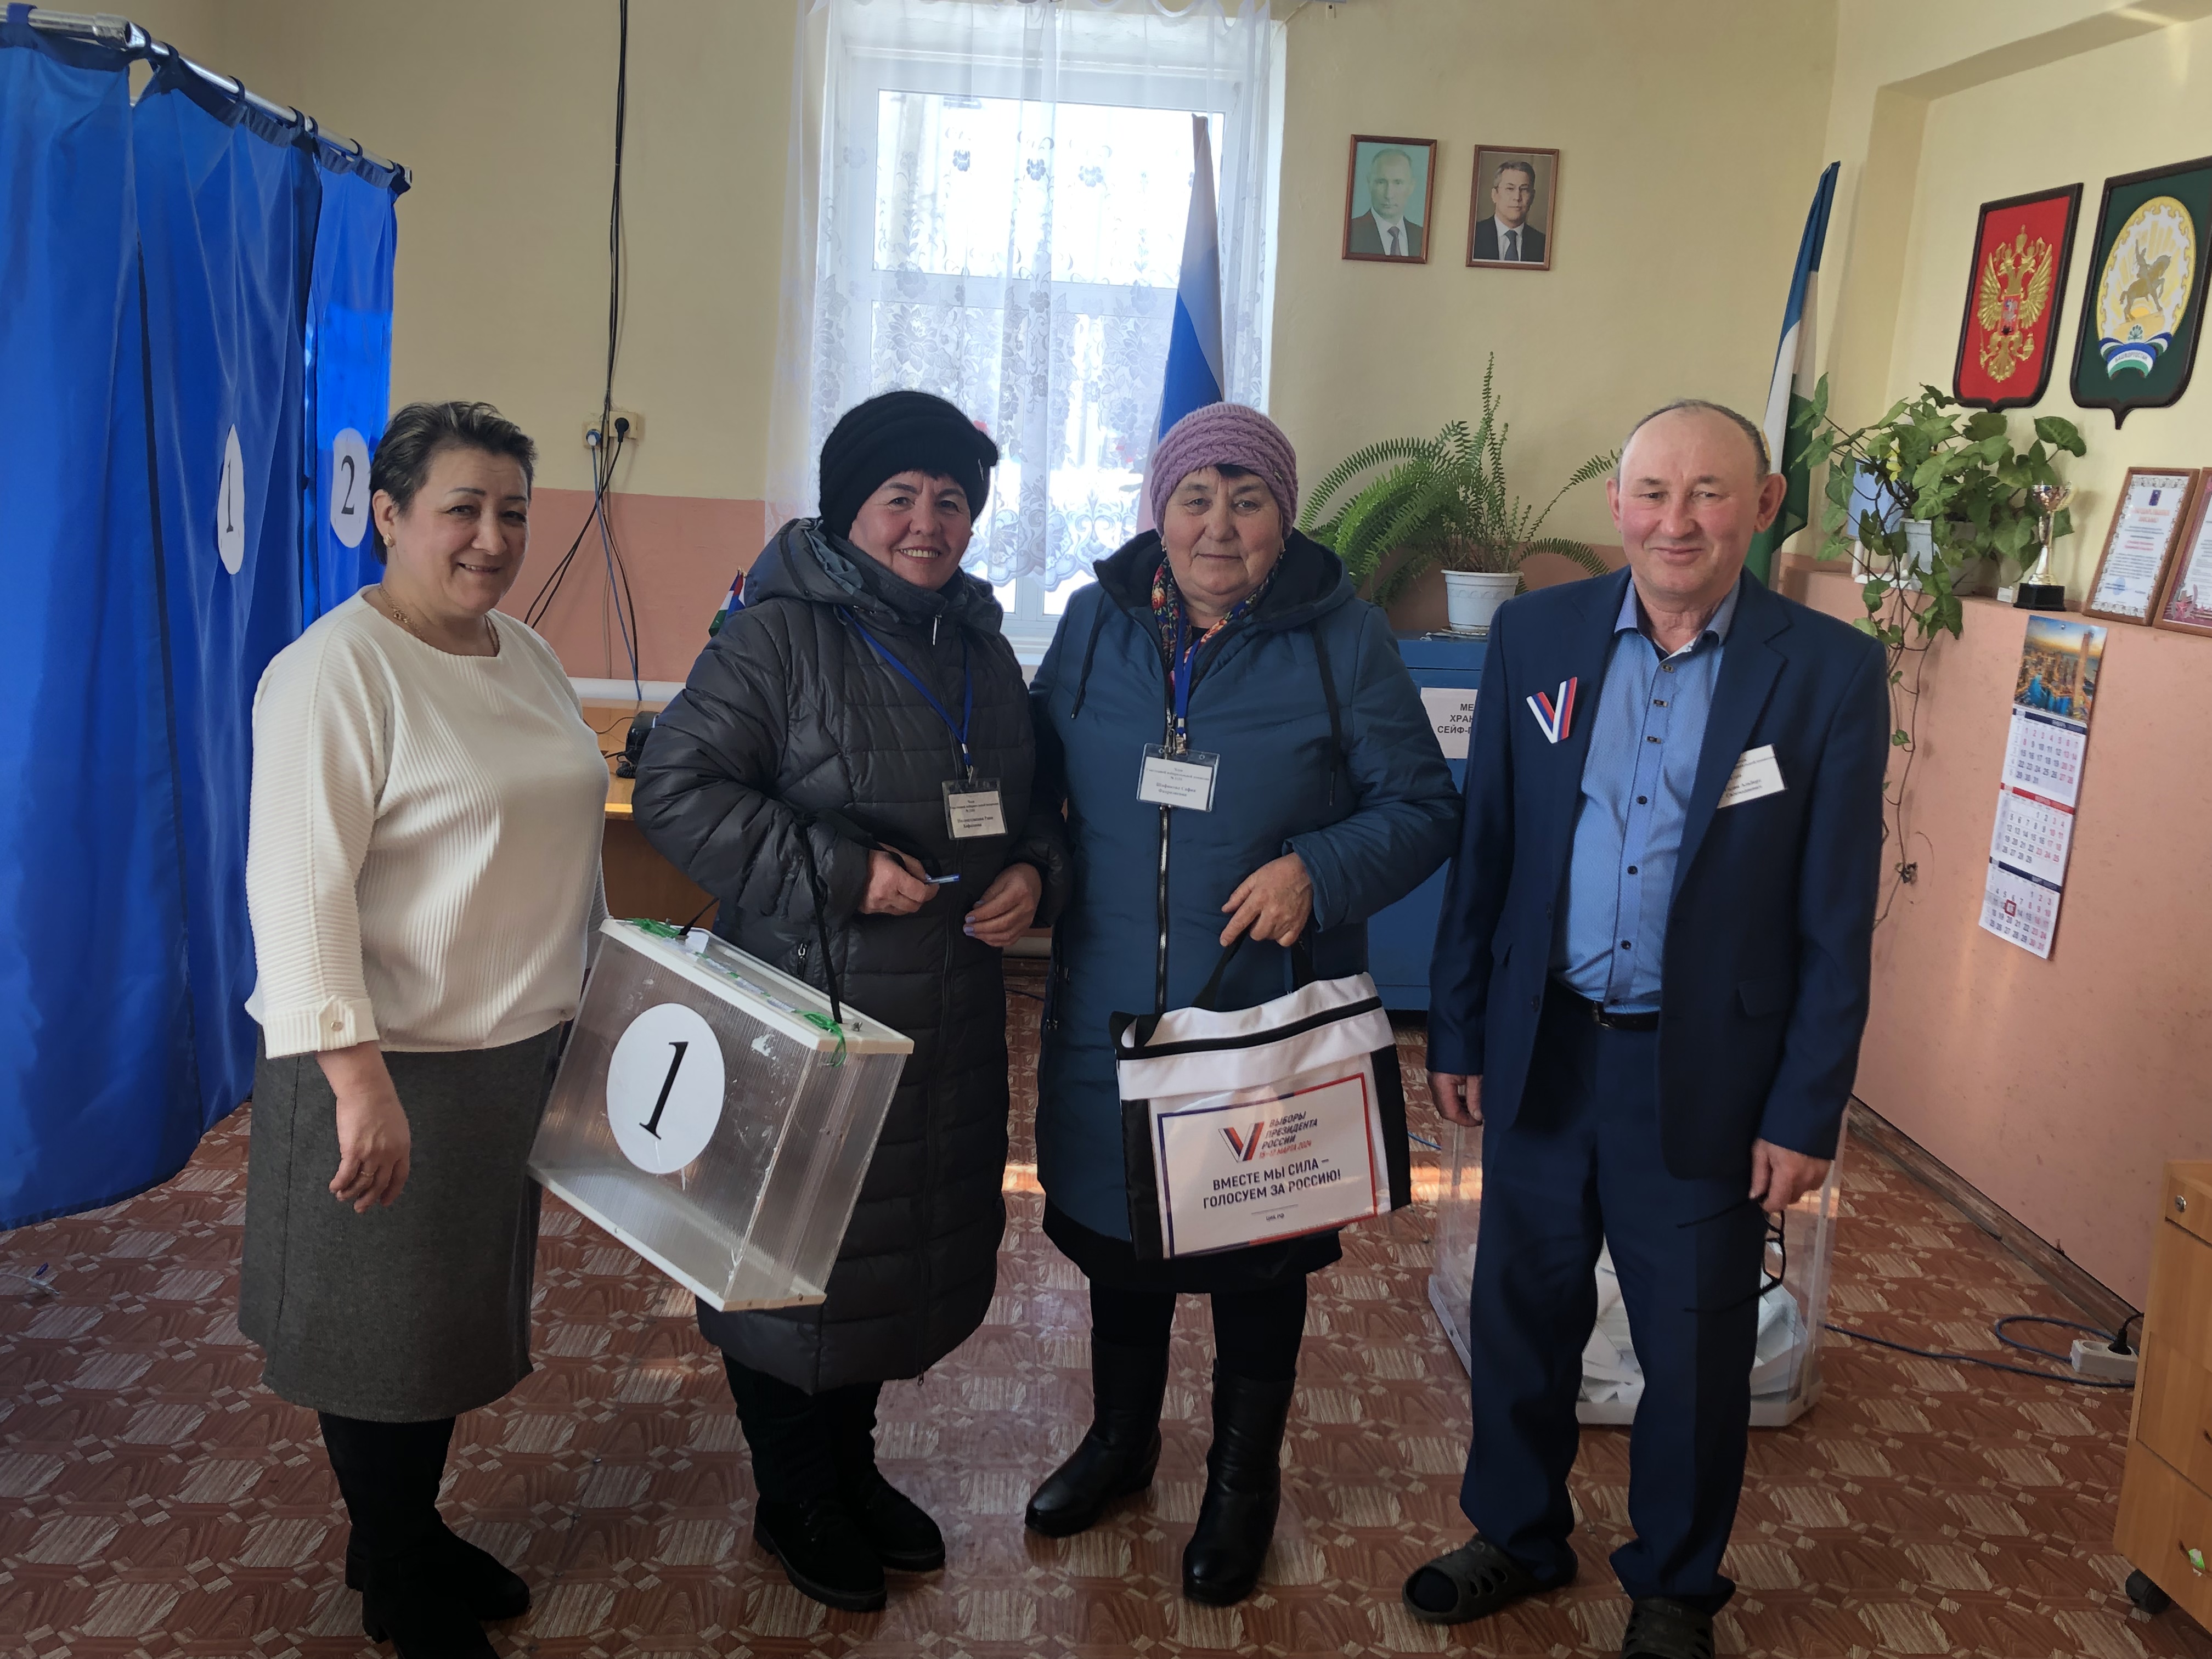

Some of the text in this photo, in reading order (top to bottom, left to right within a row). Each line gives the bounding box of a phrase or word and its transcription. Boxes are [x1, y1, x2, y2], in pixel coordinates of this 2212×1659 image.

[226, 459, 234, 533] 1
[341, 455, 355, 515] 2
[639, 1041, 689, 1139] 1
[1265, 1118, 1318, 1138] ПРЕЗИДЕНТА
[1269, 1111, 1306, 1127] ВЫБОРЫ
[1262, 1135, 1296, 1149] РОССИИ
[1203, 1169, 1341, 1209] ГОЛОСУЕМ ЗА РОССИЮ!
[1213, 1171, 1260, 1191] ВМЕСТЕ
[1264, 1166, 1285, 1181] МЫ
[1288, 1158, 1319, 1176] СИЛА
